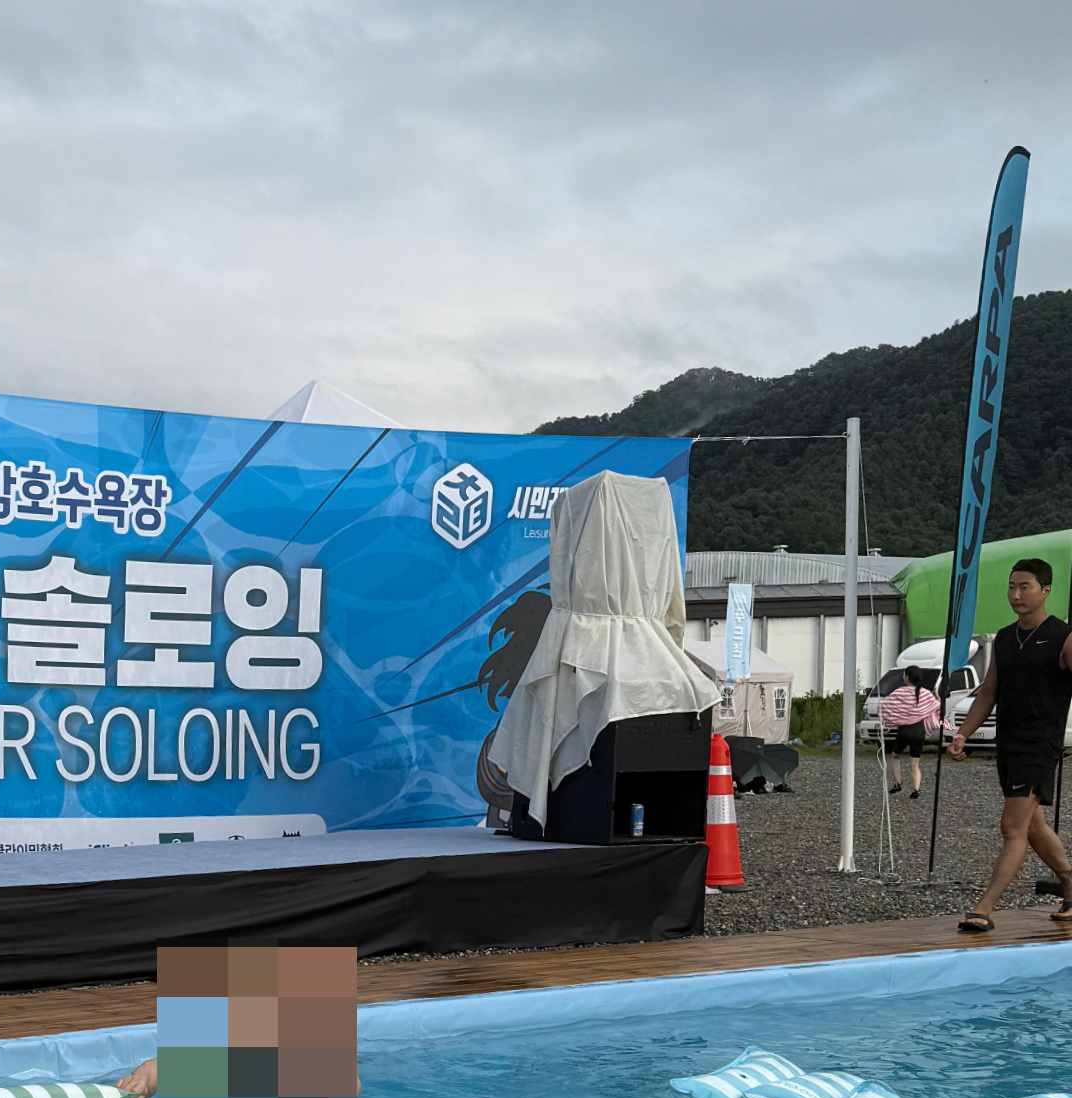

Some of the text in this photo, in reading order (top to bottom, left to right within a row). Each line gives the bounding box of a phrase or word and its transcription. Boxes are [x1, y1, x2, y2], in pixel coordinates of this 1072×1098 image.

[523, 526, 551, 539] Leisur
[1, 555, 324, 691] 솔로잉
[55, 706, 321, 783] SOLOING
